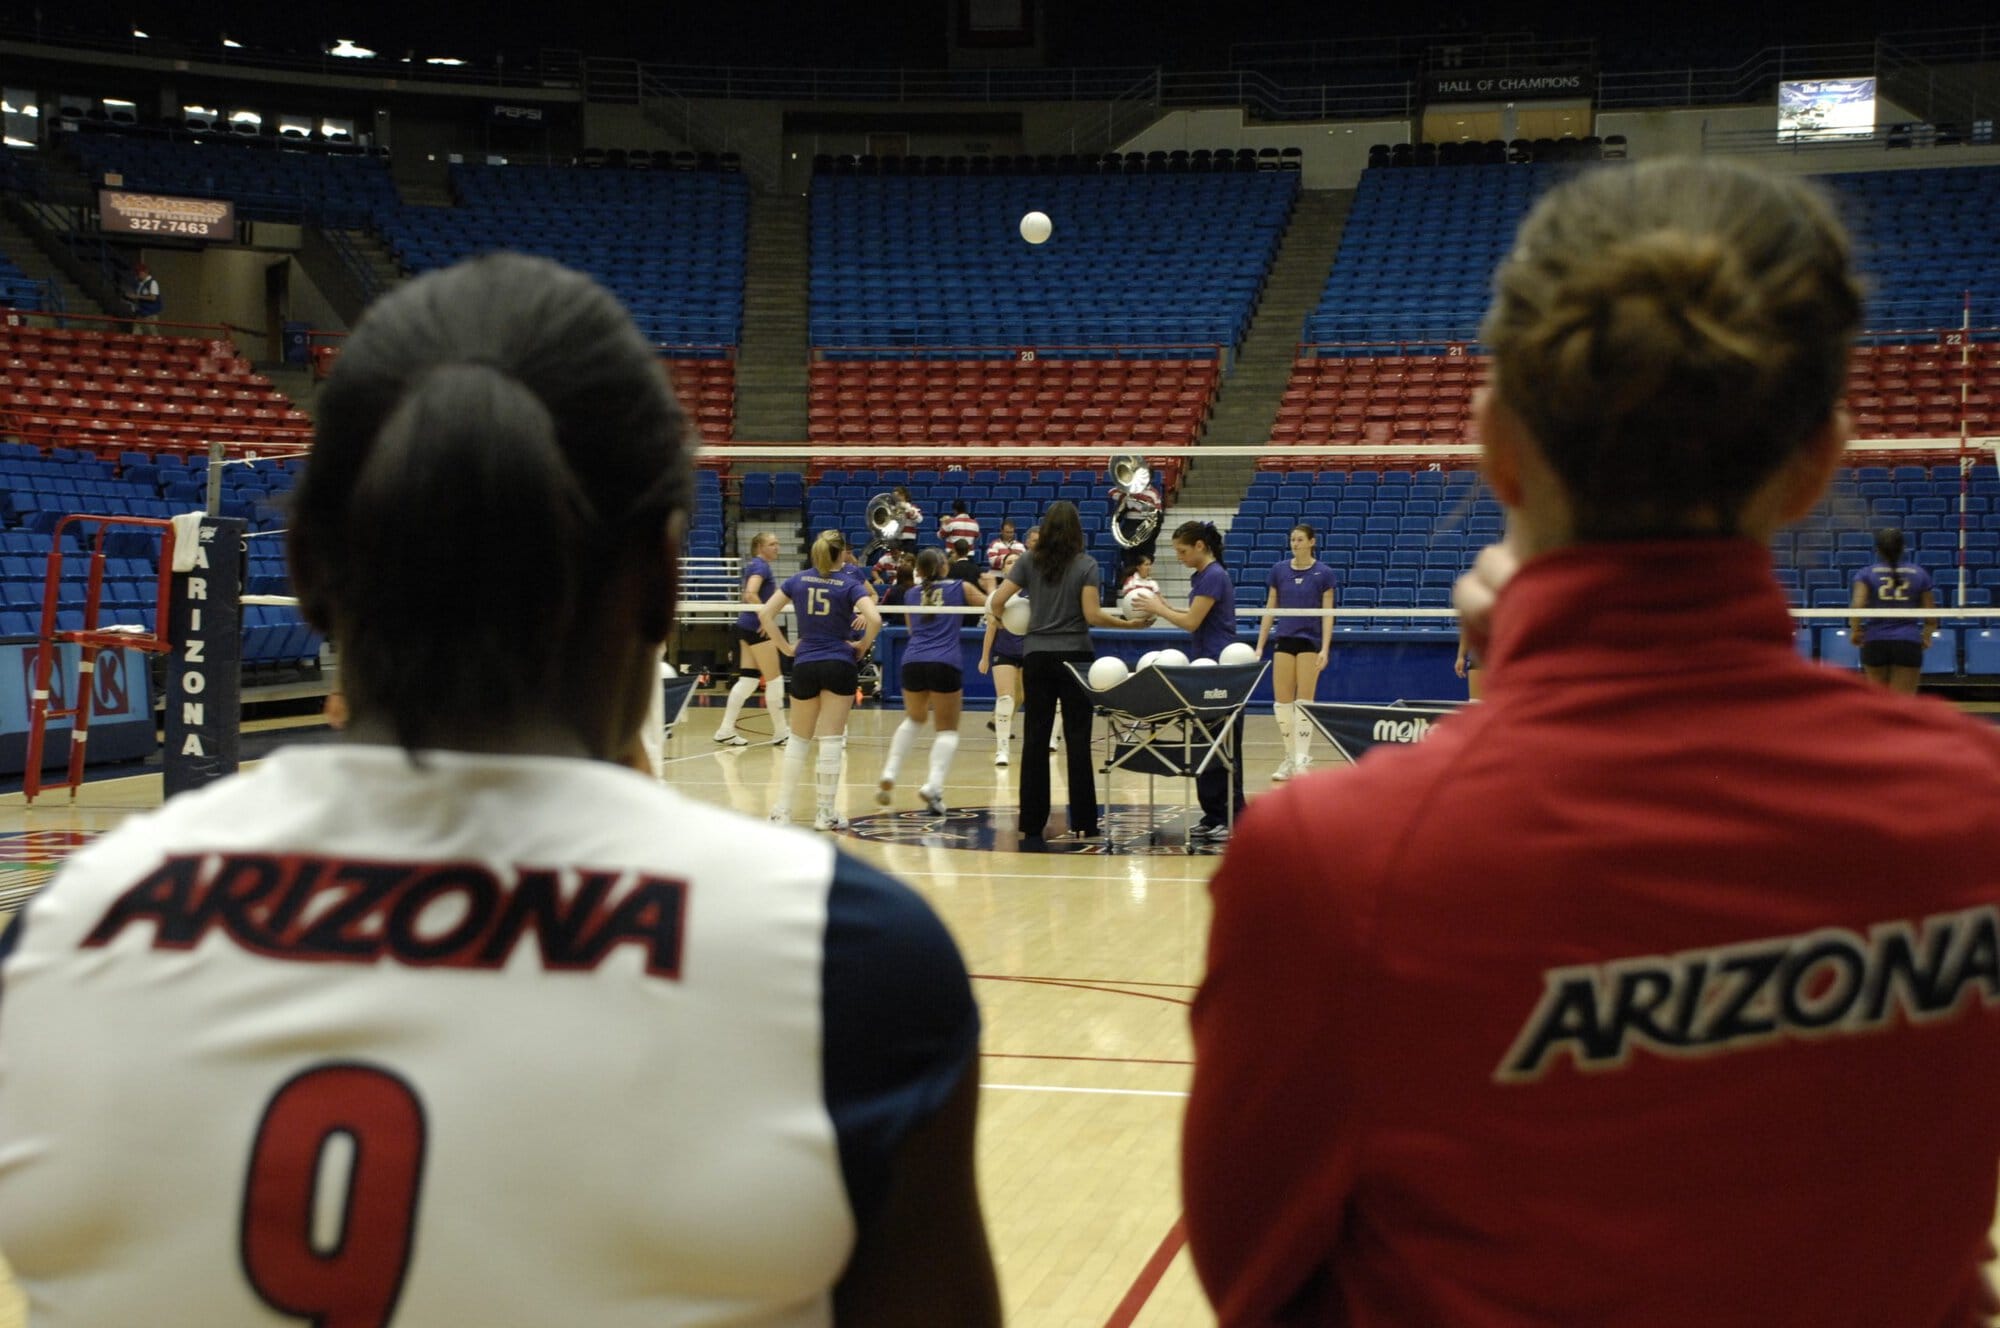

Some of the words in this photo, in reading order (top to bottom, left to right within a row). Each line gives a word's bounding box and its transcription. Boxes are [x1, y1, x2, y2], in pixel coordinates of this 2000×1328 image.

[1438, 80, 1472, 92] HALL
[1477, 79, 1494, 91] OF
[1499, 76, 1580, 90] CHAMPIONS
[494, 105, 542, 120] PEPSI
[130, 217, 209, 234] 327-7463
[1946, 334, 1962, 345] 22
[1021, 351, 1035, 361] 20
[1449, 346, 1463, 356] 21
[1878, 576, 1911, 601] 22
[807, 587, 831, 616] 15
[181, 546, 209, 756] ARIZONA
[76, 851, 690, 983] ARIZONA
[1494, 903, 2000, 1083] ARIZONA
[238, 1058, 430, 1328] 9
